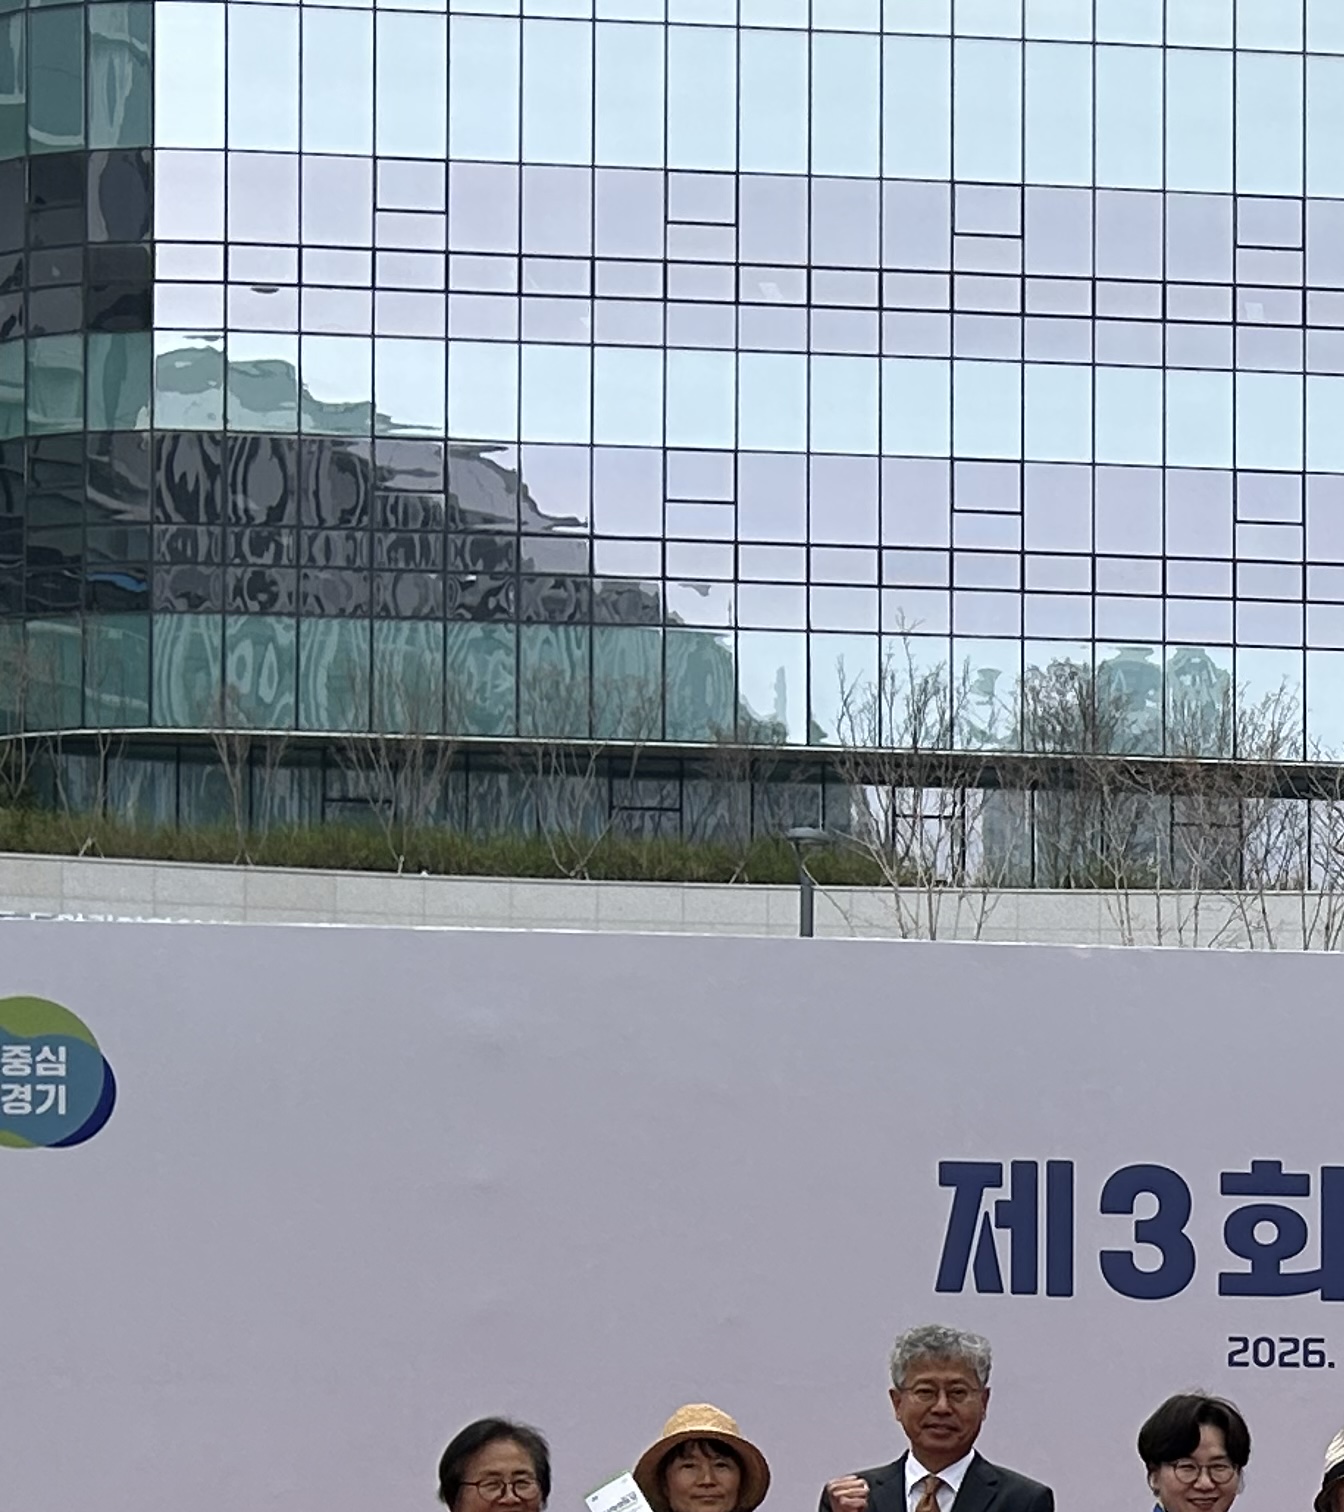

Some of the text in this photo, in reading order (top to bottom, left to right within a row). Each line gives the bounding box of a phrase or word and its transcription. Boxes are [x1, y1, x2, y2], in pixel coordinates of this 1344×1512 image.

[1, 1045, 67, 1077] 중심
[1, 1083, 67, 1115] 경기
[1227, 1336, 1335, 1368] 2026.
